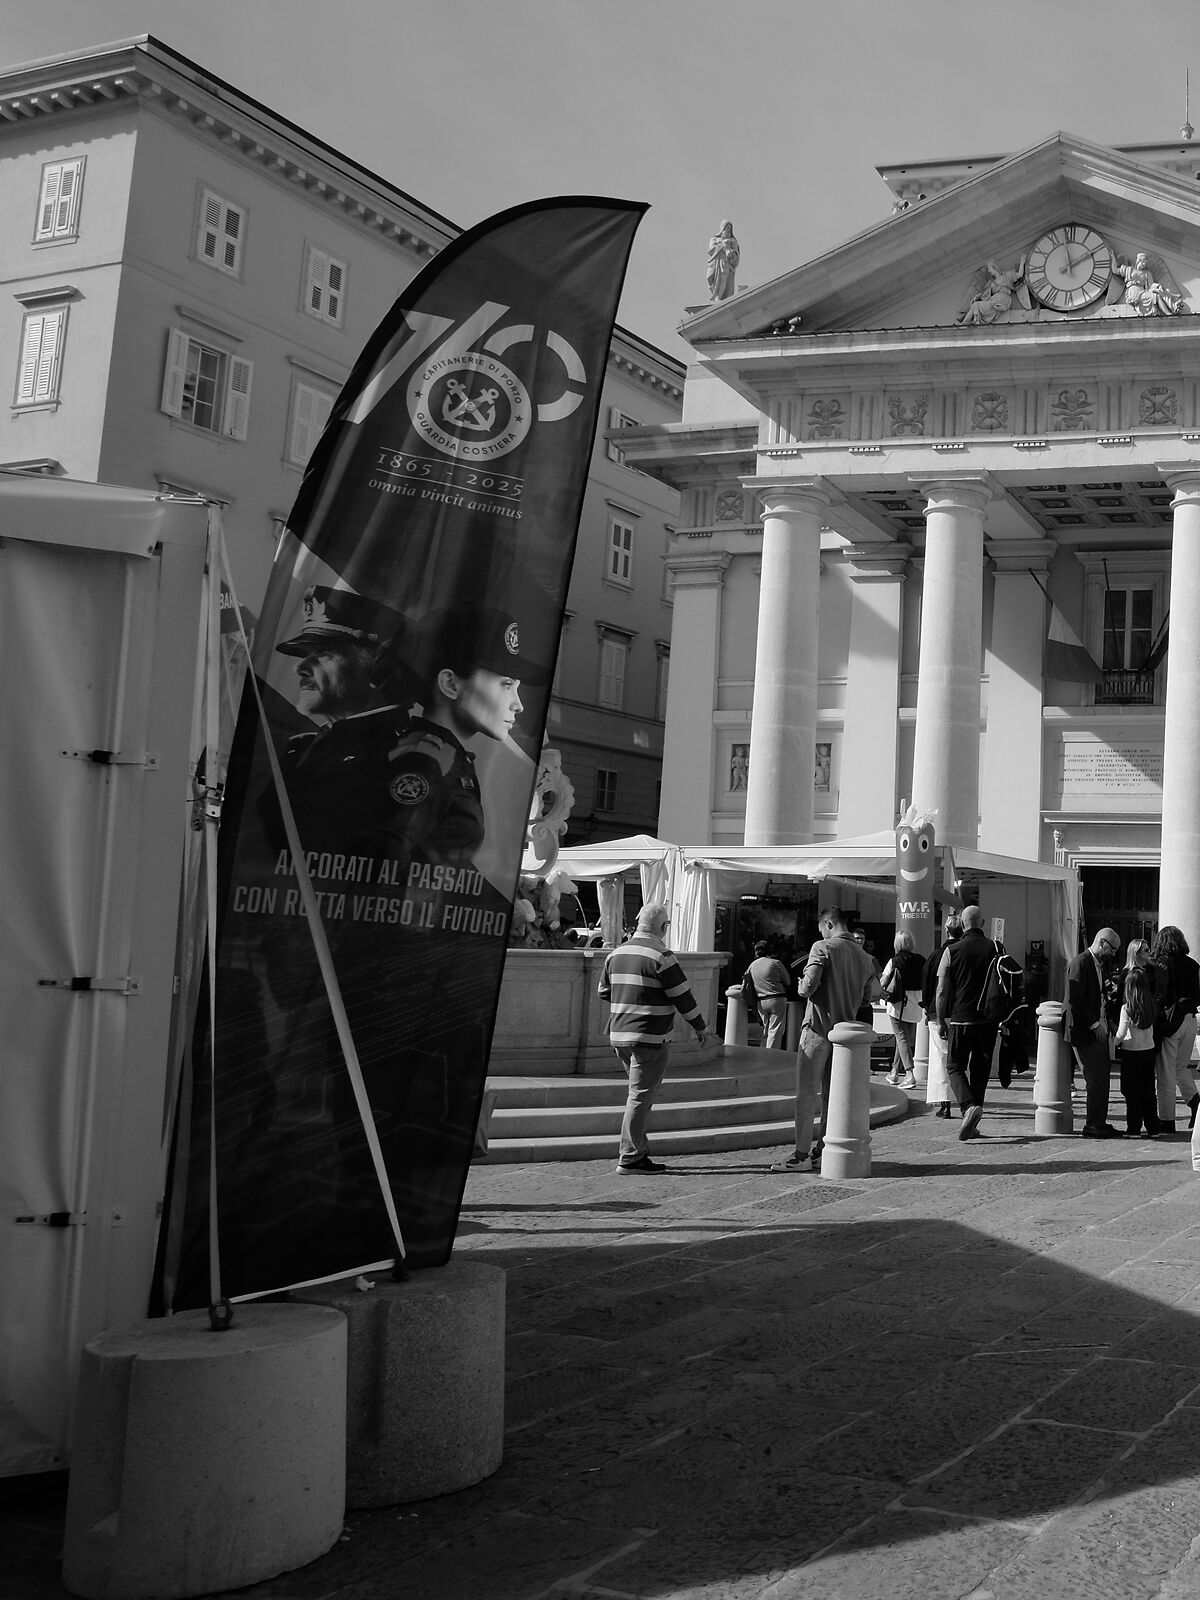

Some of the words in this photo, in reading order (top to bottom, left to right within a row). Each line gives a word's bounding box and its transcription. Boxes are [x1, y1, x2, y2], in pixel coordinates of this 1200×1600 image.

[423, 357, 485, 381] CAPITANERIE
[488, 363, 500, 374] DI
[501, 373, 522, 404] PORTO
[416, 412, 457, 451] GUARDIA
[462, 432, 517, 456] COSTIERA
[376, 453, 433, 476] 1865
[466, 474, 524, 497] 2025
[368, 478, 417, 497] omnia
[421, 488, 465, 507] vincit
[467, 501, 523, 519] animus
[377, 859, 400, 886] AL
[407, 862, 484, 896] PASSATO
[233, 886, 278, 915] CON
[353, 895, 414, 926] VERSO
[418, 902, 435, 928] IL
[441, 903, 507, 937] FUTURO
